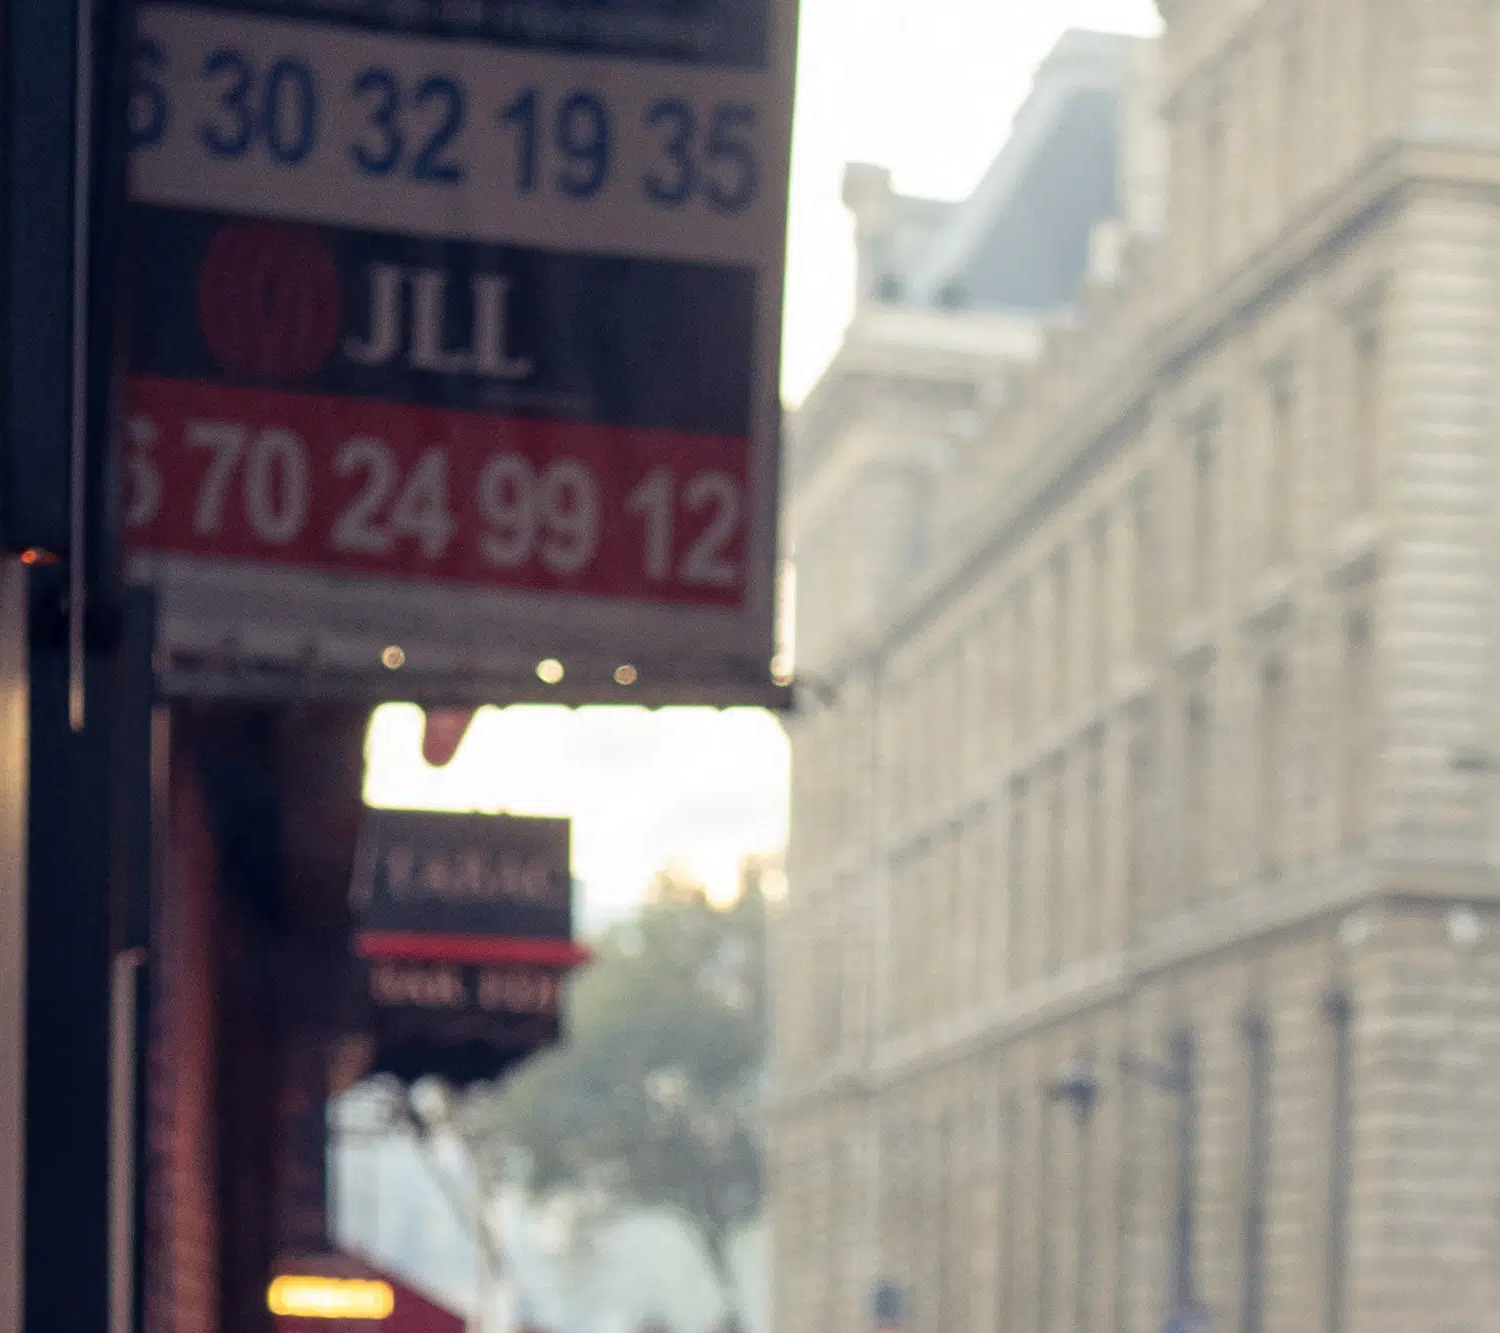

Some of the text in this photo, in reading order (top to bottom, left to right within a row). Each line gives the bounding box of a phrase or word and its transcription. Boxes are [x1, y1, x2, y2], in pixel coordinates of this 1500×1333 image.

[199, 48, 318, 168] 30
[350, 68, 465, 185] 32
[503, 86, 610, 200] 19
[641, 98, 759, 212] 35
[342, 262, 535, 380] JLL
[186, 421, 310, 544] 70
[329, 438, 455, 560] 24
[476, 454, 600, 573] 99
[624, 470, 742, 588] 12
